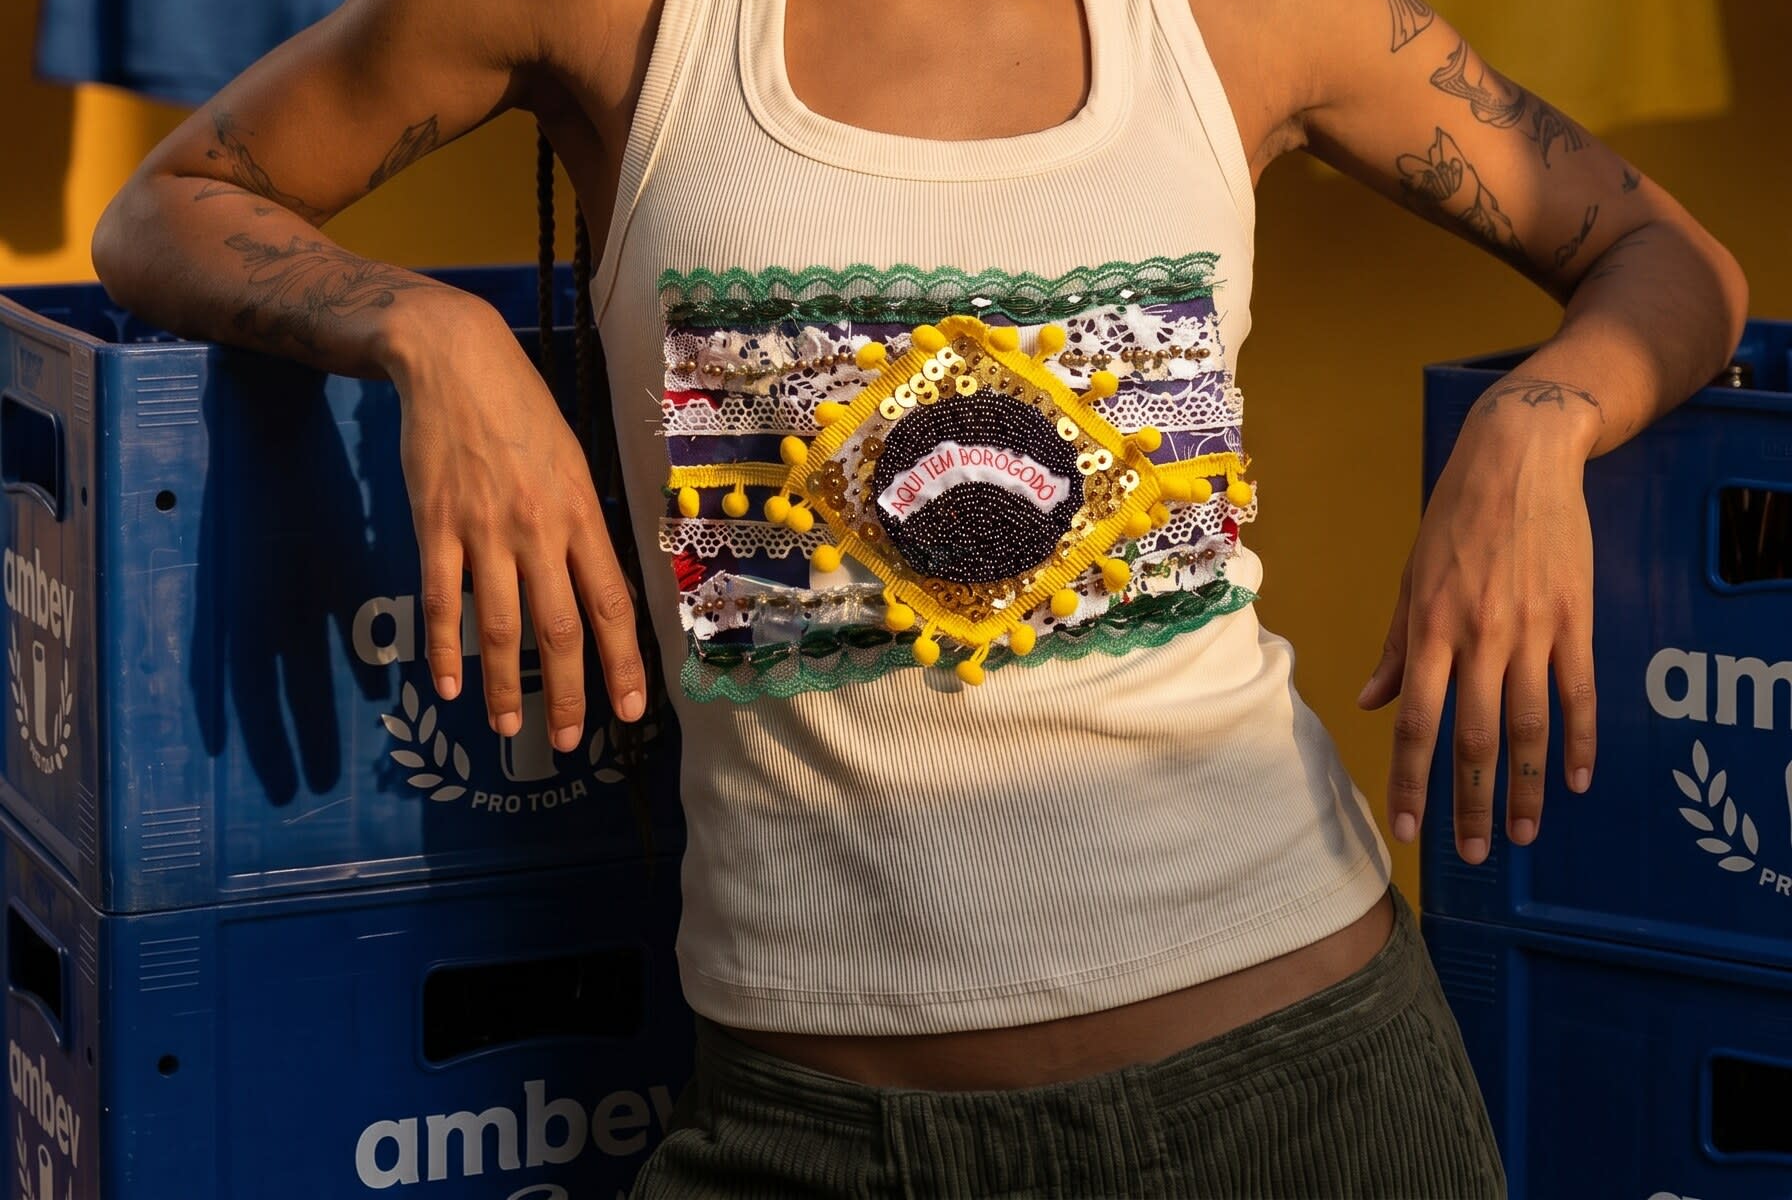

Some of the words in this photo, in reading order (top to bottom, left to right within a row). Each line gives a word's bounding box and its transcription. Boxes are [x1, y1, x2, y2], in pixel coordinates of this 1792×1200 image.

[891, 471, 925, 514] AQUI
[920, 451, 955, 480] TEM
[3, 546, 74, 649] ambey
[471, 790, 521, 814] PRO
[527, 778, 588, 812] TOLA
[8, 1038, 81, 1168] ambey
